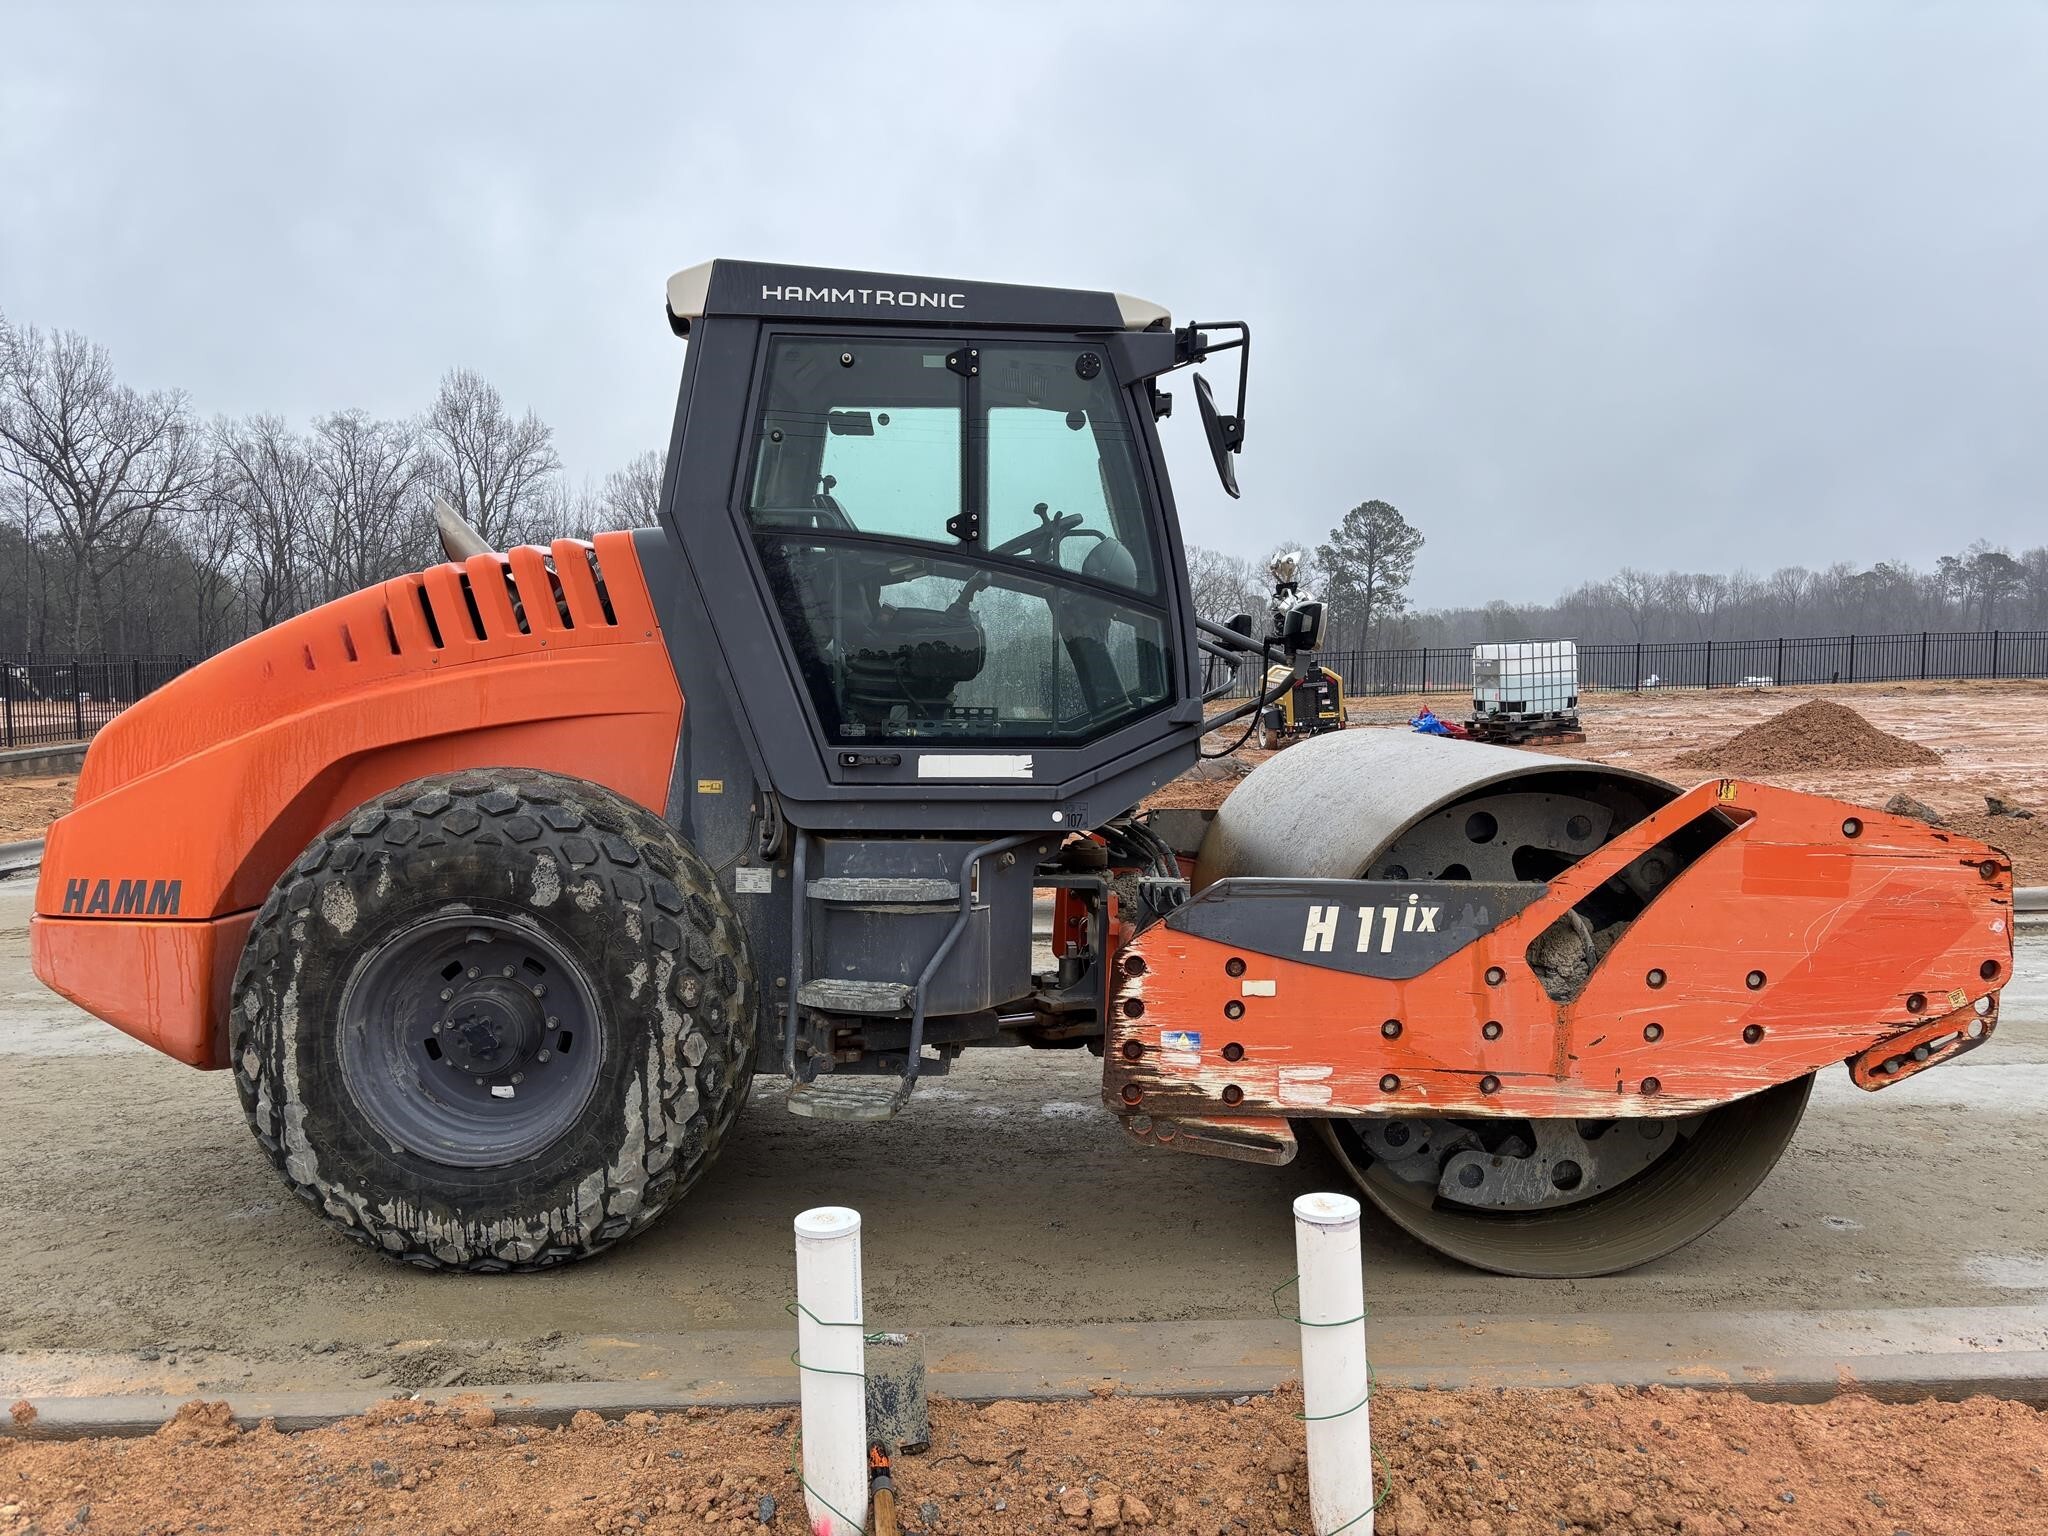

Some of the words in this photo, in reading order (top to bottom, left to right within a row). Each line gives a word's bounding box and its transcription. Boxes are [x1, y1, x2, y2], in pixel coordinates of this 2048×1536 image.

[762, 285, 966, 309] HAMMTRONIC
[1065, 813, 1083, 828] 107
[62, 878, 182, 915] HAMM
[1302, 905, 1340, 952] H
